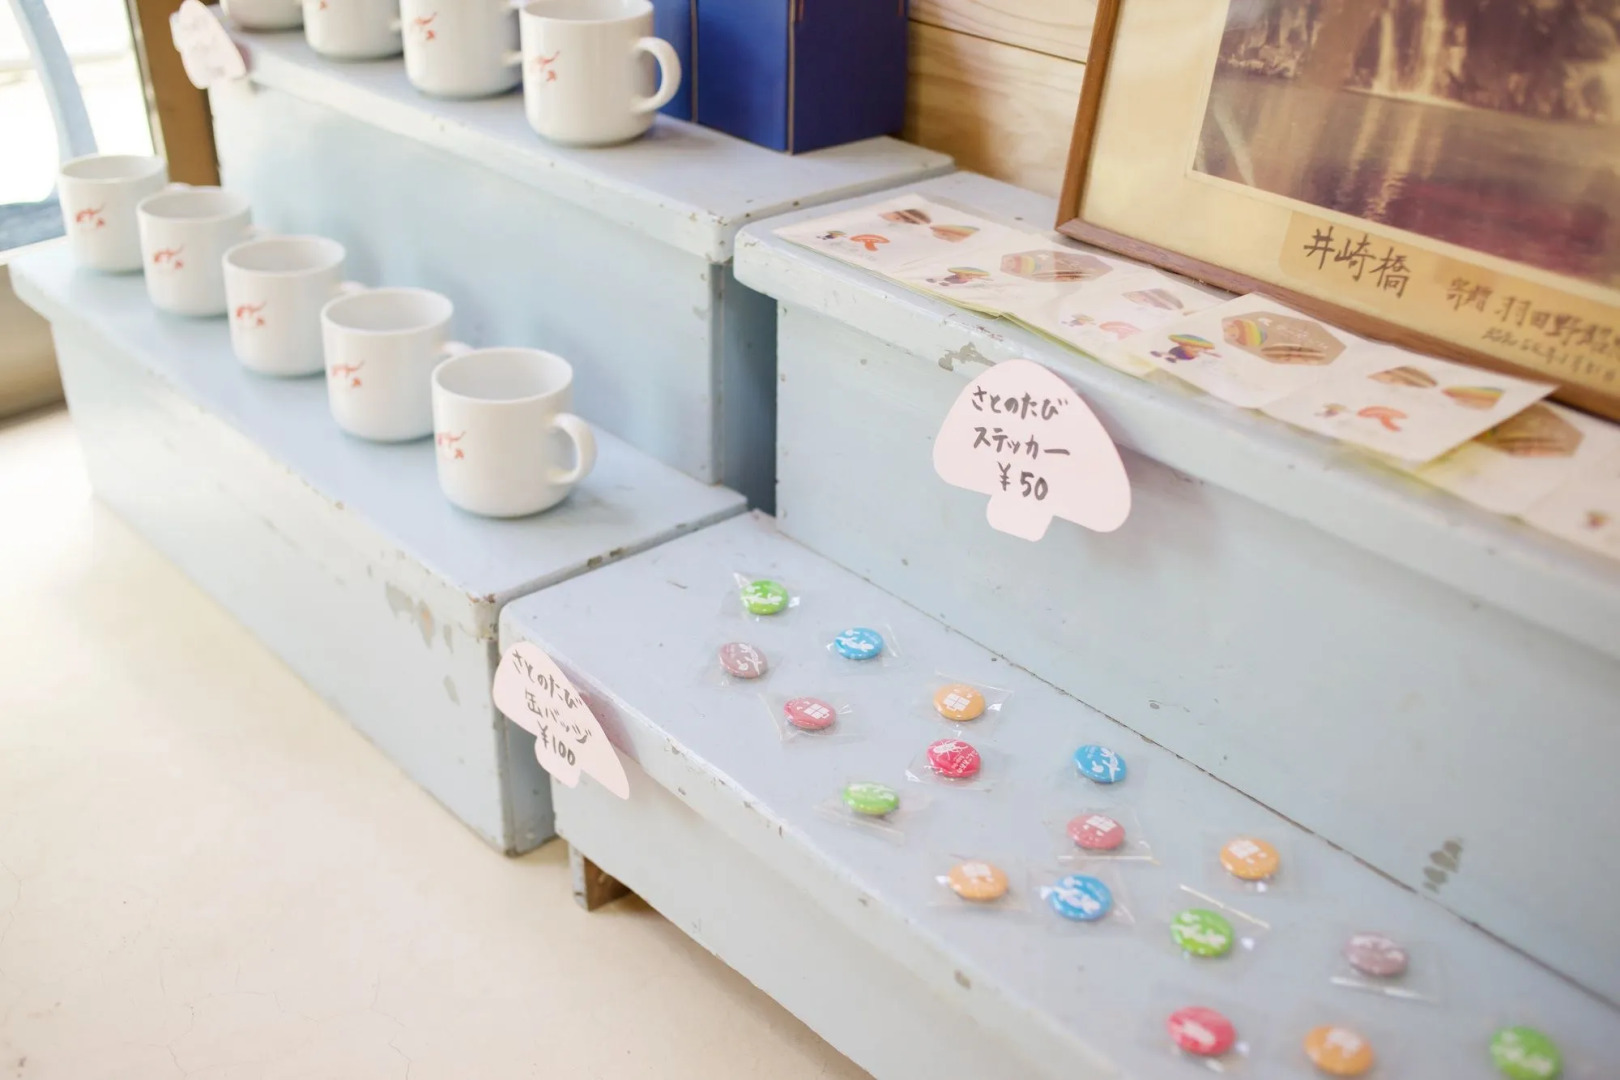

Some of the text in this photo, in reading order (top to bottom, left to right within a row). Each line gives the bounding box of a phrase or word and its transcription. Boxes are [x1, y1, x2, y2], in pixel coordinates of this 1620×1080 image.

[1303, 225, 1411, 299] 井崎橋
[972, 385, 1068, 420] さとのたび
[973, 426, 1071, 460] ステッカー
[512, 649, 582, 709] さとのたび
